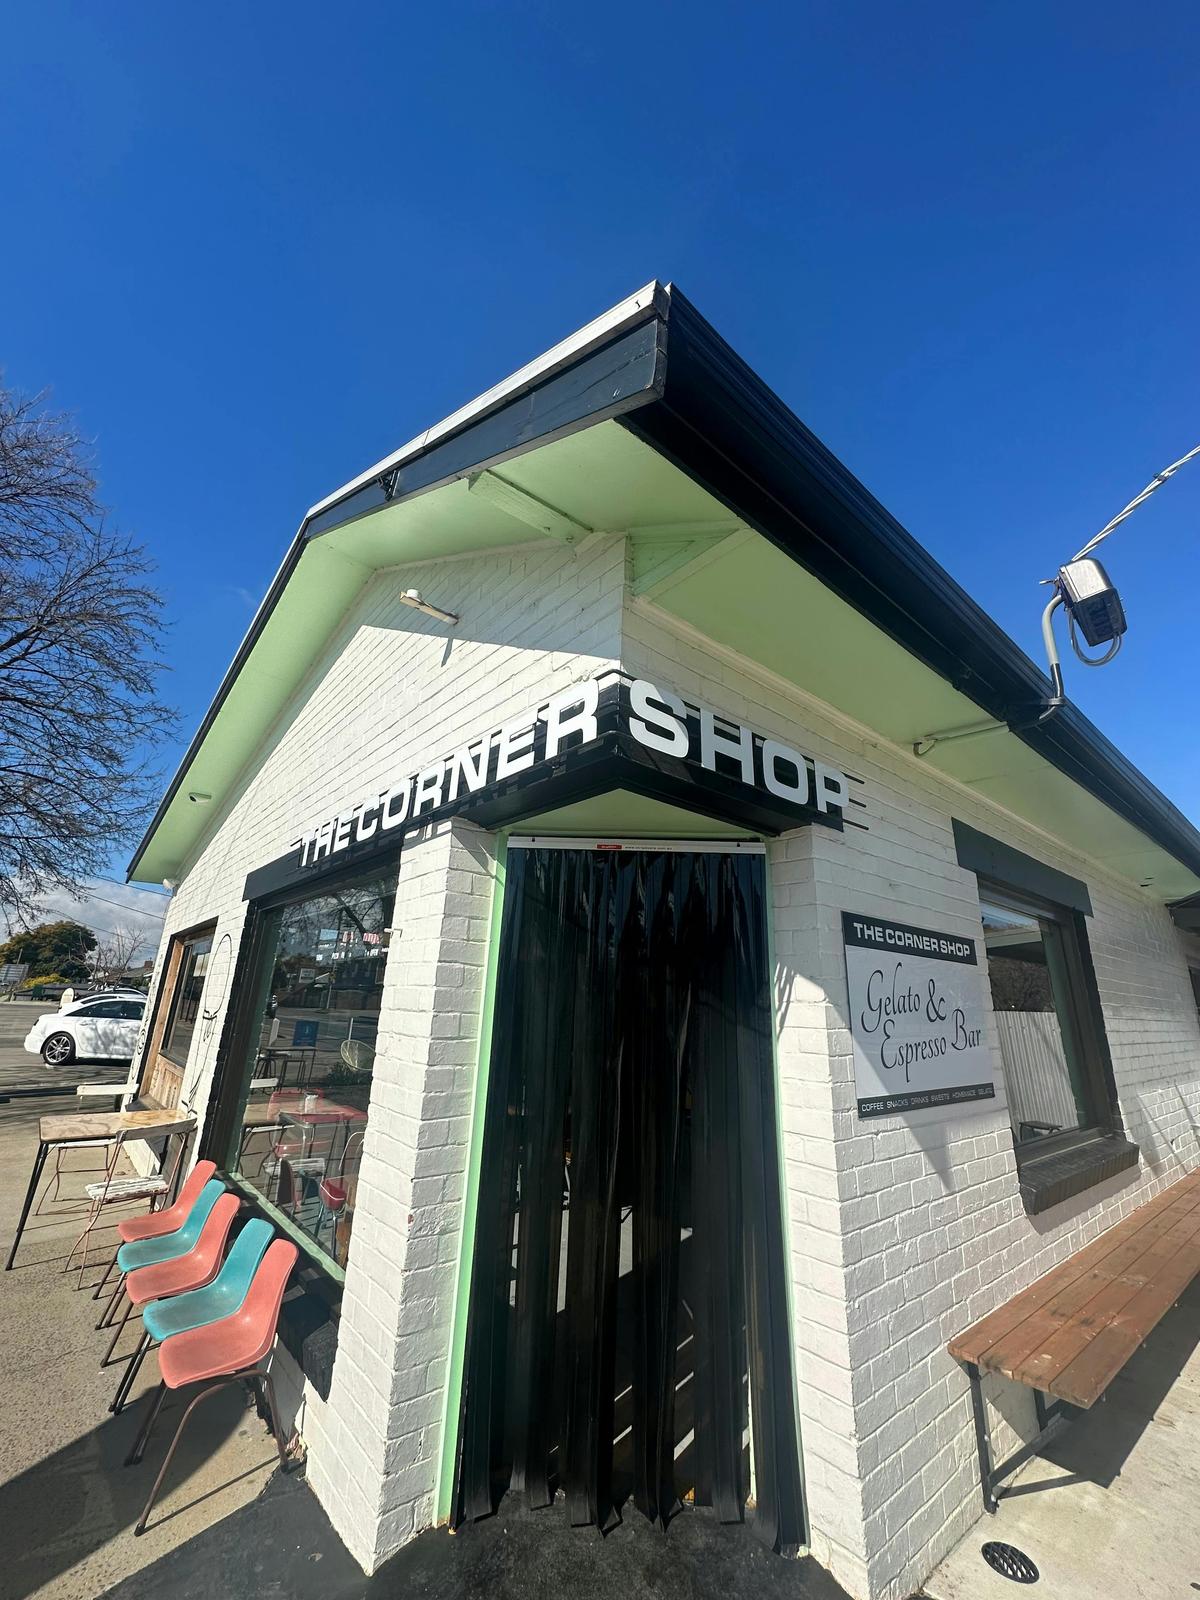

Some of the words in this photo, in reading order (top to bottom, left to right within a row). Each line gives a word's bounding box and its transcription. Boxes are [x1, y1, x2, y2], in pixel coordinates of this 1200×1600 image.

[300, 808, 353, 867] THE
[356, 680, 599, 841] CORNER
[630, 679, 849, 813] SHOP
[853, 922, 884, 942] THE
[885, 929, 939, 952] CORNER
[940, 939, 970, 957] SHOP
[861, 962, 920, 1033] Gelato
[926, 978, 947, 1022] &
[881, 1018, 947, 1083] Espresso
[951, 1008, 981, 1051] Bar
[861, 1102, 884, 1112] COFFEE
[886, 1098, 909, 1109] SNACKS
